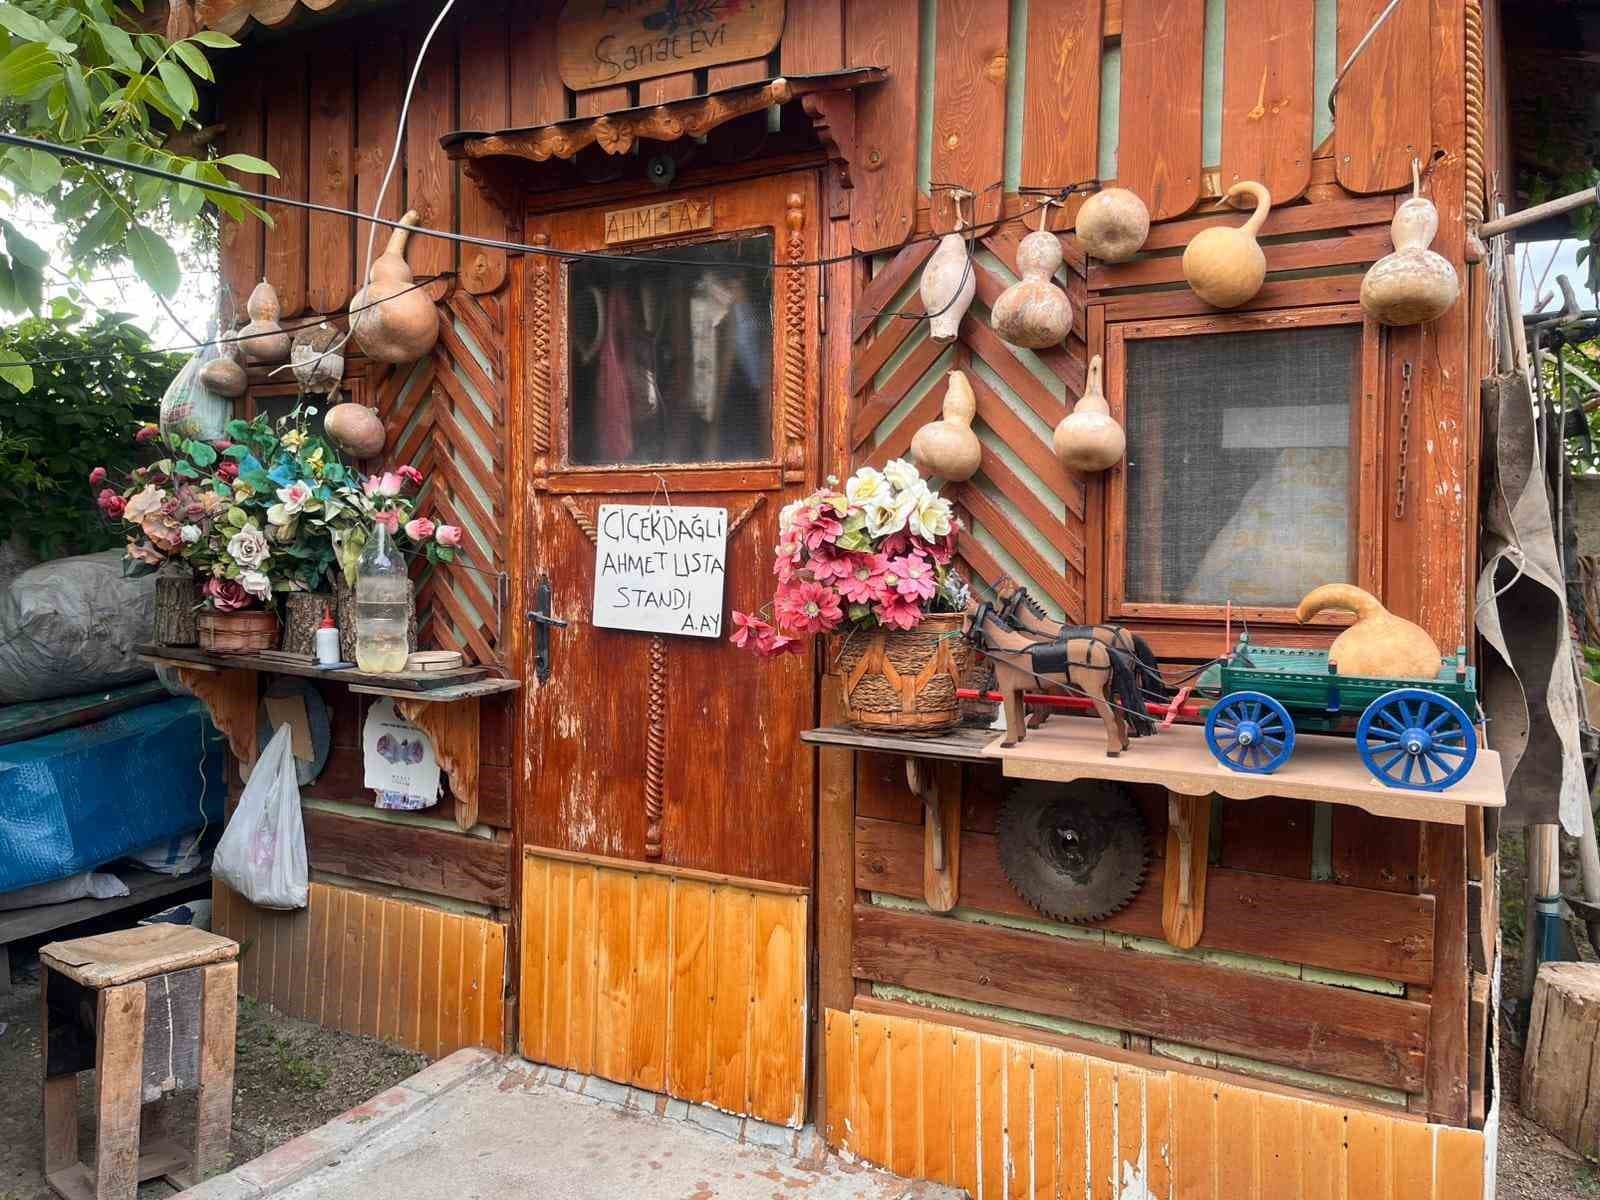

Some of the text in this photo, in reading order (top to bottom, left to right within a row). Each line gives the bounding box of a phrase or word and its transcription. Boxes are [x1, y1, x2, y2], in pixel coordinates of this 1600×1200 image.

[588, 34, 684, 84] Sanat
[601, 551, 726, 577] AHMET USTA
[612, 586, 692, 611] STANDI
